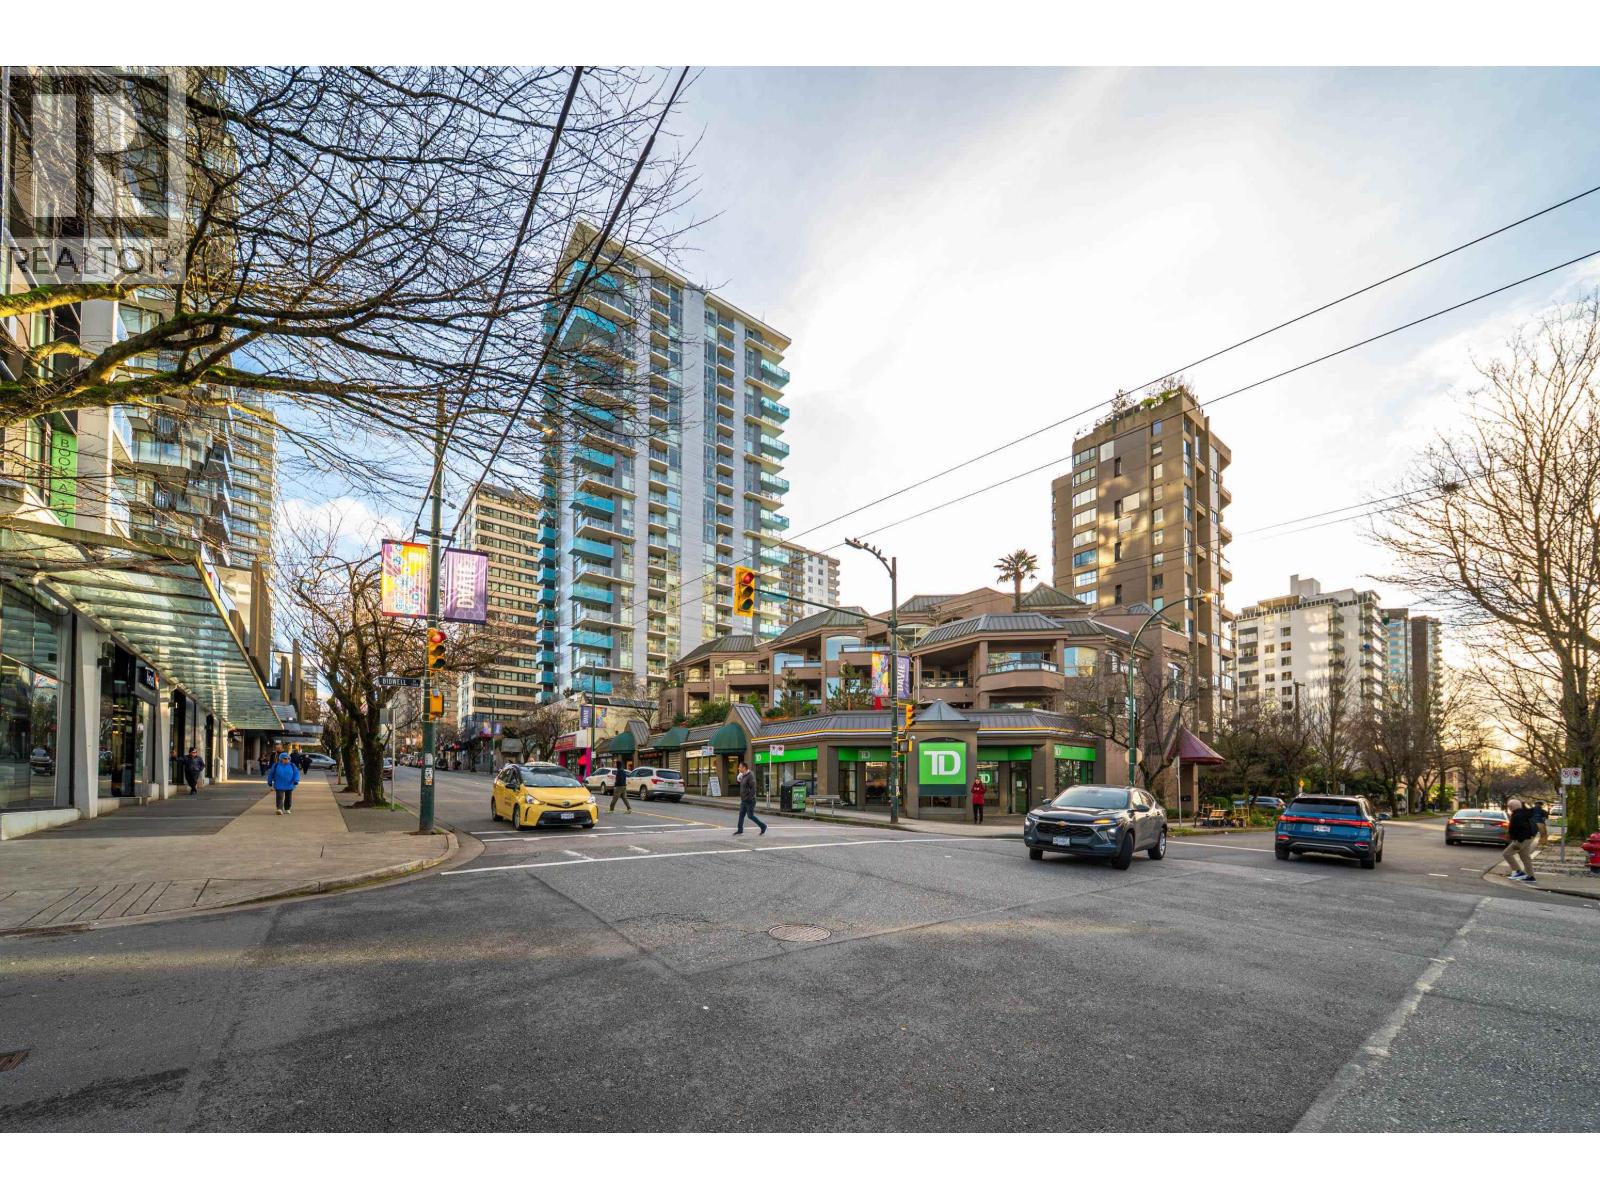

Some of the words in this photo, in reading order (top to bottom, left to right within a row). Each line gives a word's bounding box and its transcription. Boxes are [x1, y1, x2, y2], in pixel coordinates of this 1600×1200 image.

[58, 439, 71, 477] BOOK
[382, 678, 407, 686] BIDWELL
[896, 663, 906, 691] DAVIE
[858, 750, 871, 760] TD
[923, 750, 961, 776] TD
[979, 773, 990, 783] TD
